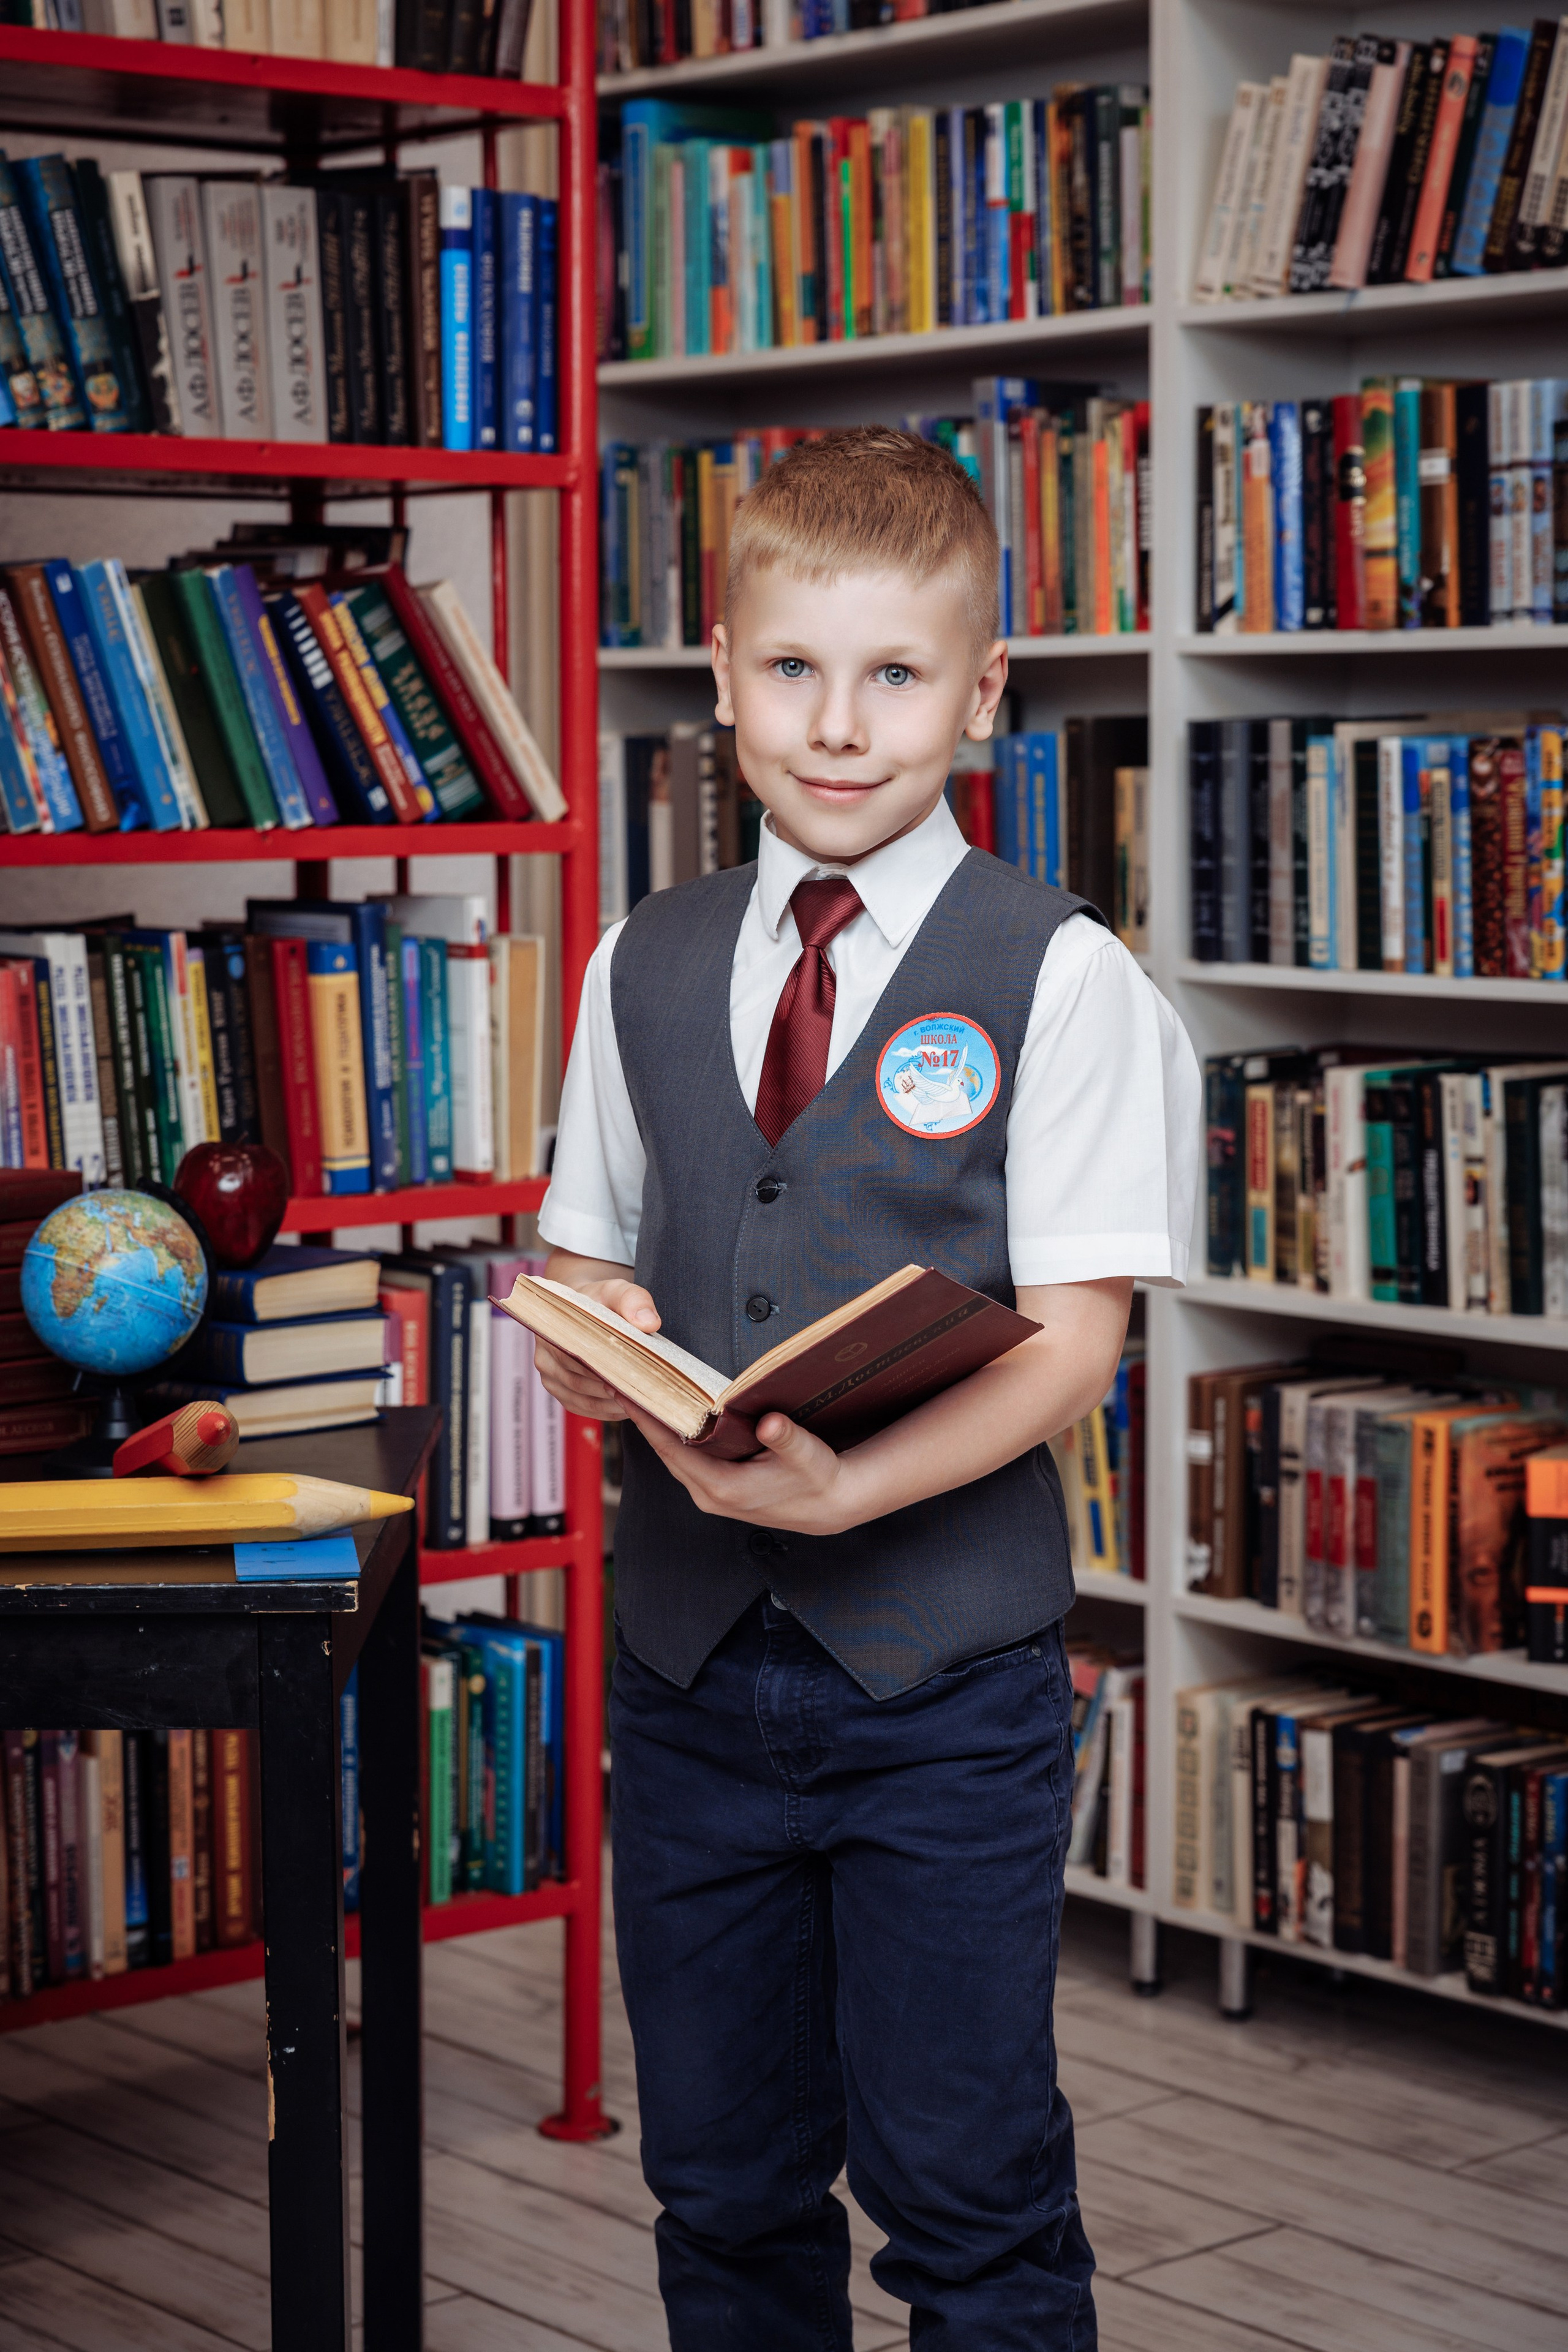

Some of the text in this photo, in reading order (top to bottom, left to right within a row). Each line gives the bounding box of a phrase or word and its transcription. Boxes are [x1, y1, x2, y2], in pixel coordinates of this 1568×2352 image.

[920, 1022, 965, 1034] ВОЛЖСКИЙ
[921, 1034, 957, 1045] ШКОЛА
[918, 1049, 960, 1068] №17
